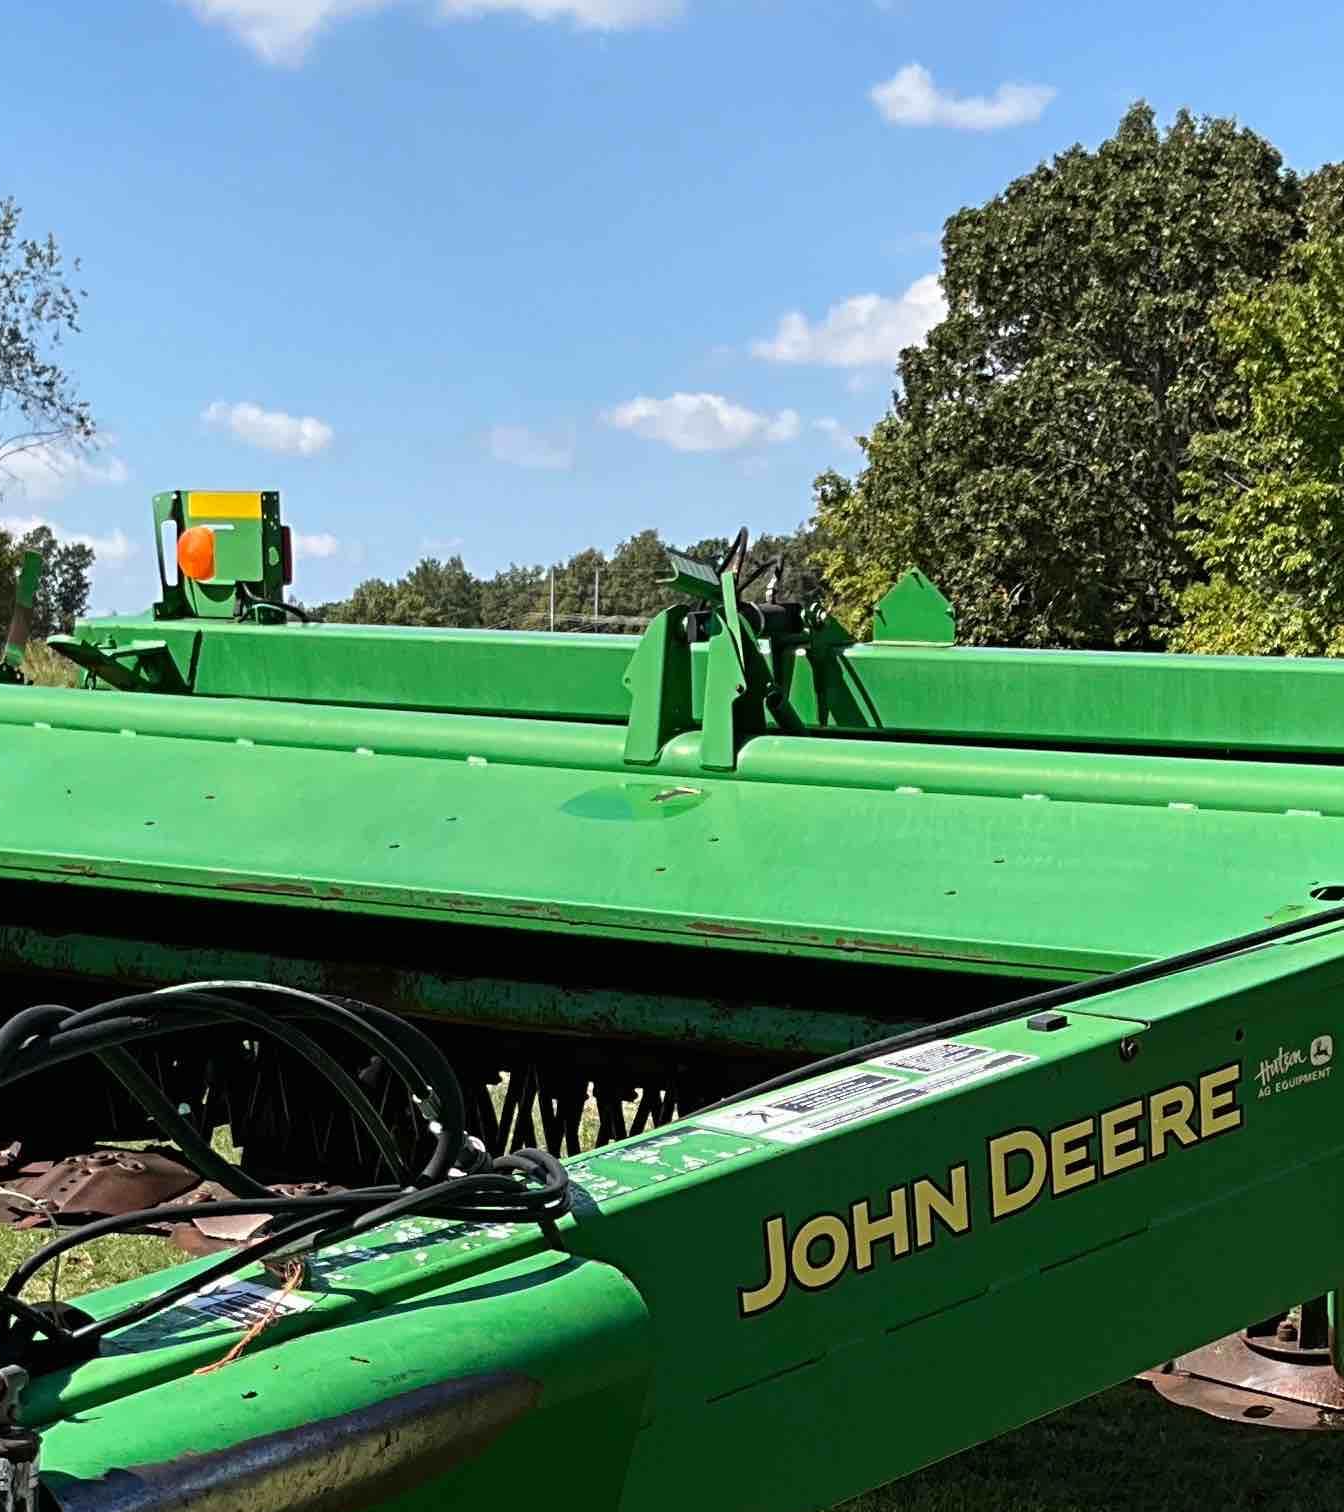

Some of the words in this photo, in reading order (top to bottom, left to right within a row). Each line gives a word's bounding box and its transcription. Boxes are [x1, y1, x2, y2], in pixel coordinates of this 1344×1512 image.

[1258, 1086, 1271, 1098] AG
[1275, 1066, 1332, 1093] EQUIPMENT
[740, 1164, 970, 1314] JOHN
[988, 1063, 1242, 1219] DEERE
